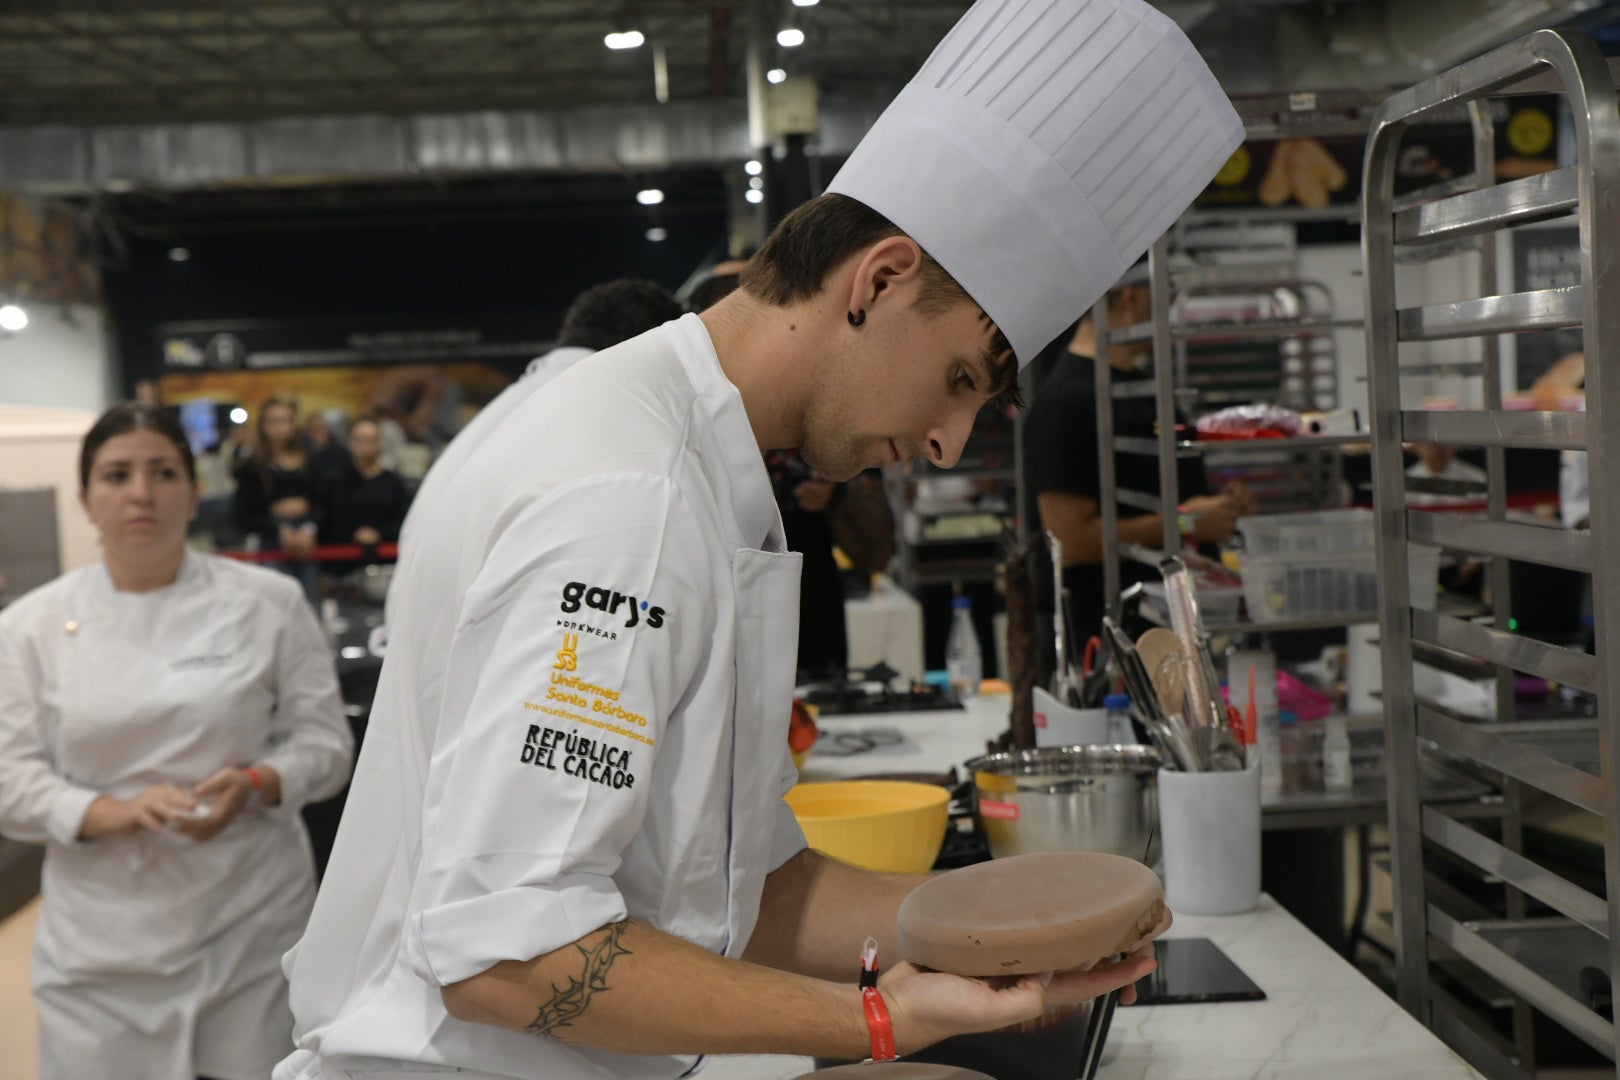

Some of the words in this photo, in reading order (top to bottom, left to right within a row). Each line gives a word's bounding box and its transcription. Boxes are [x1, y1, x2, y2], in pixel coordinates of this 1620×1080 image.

[560, 581, 666, 629] gary's
[556, 619, 618, 641] WORKWEAR
[550, 671, 621, 701] Uniformes
[520, 743, 557, 771] DEL
[525, 723, 632, 771] REPÚBLICA
